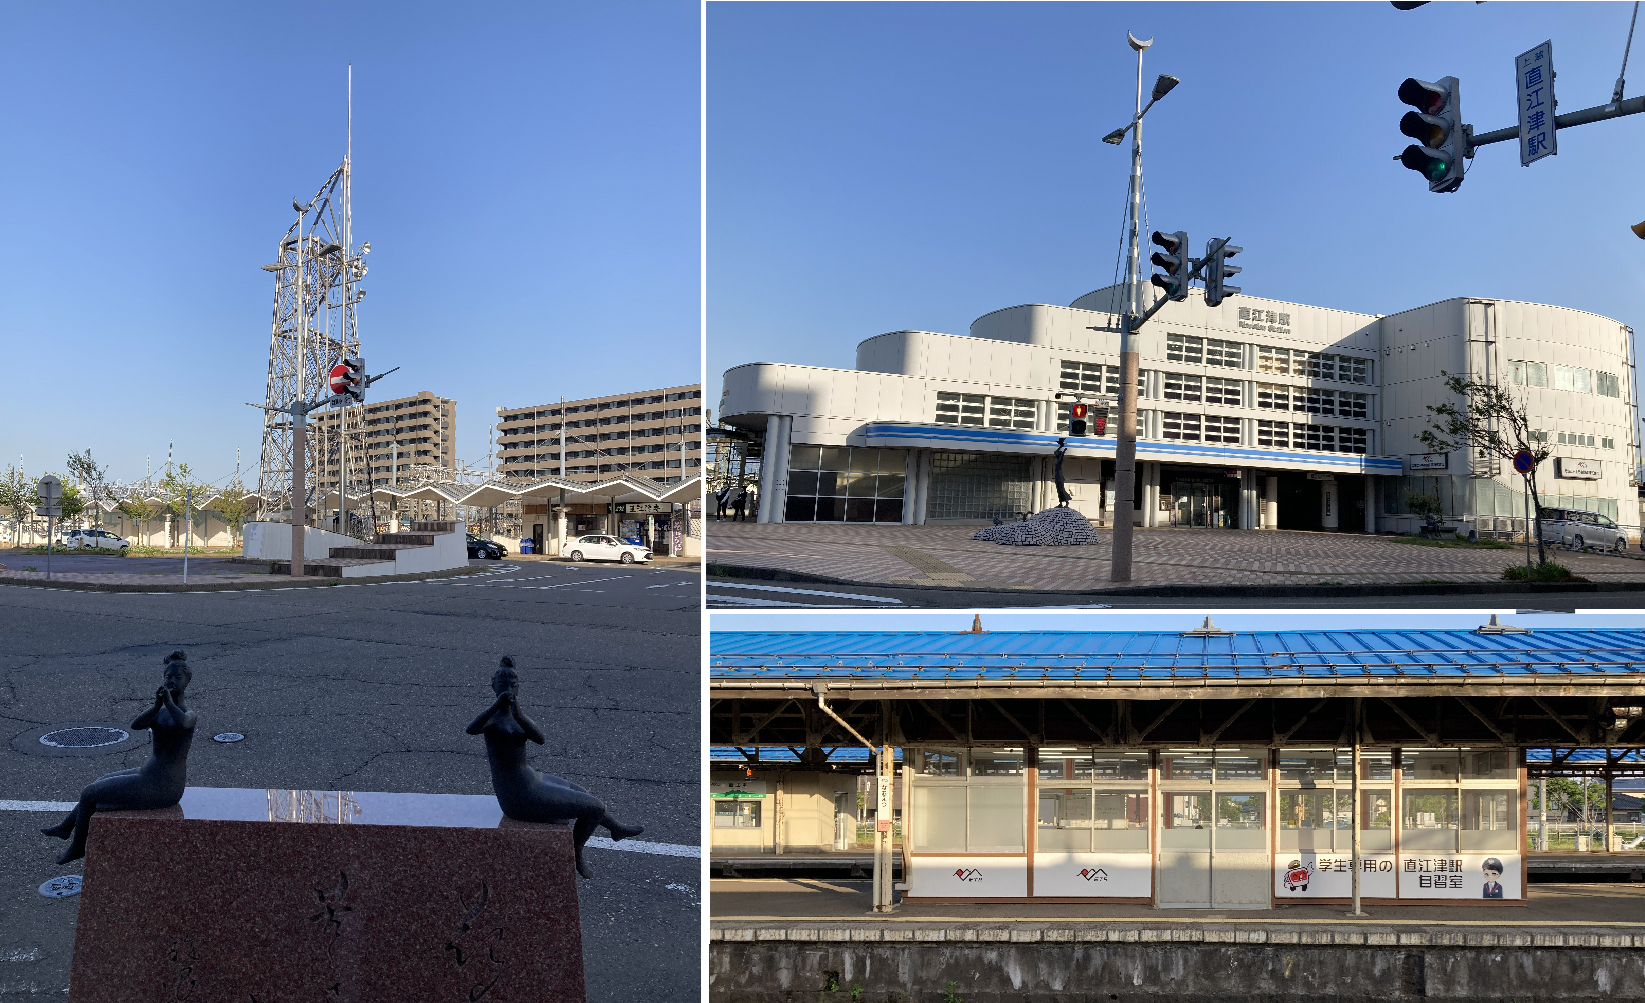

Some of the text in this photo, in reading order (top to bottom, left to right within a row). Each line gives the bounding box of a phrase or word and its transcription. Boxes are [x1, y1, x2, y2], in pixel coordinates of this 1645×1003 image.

[1523, 50, 1544, 68] 上越
[1525, 65, 1548, 157] 直江津駅
[1238, 307, 1291, 326] 直江津駅
[1404, 859, 1463, 873] 直江津駅
[1419, 875, 1463, 889] 自習室
